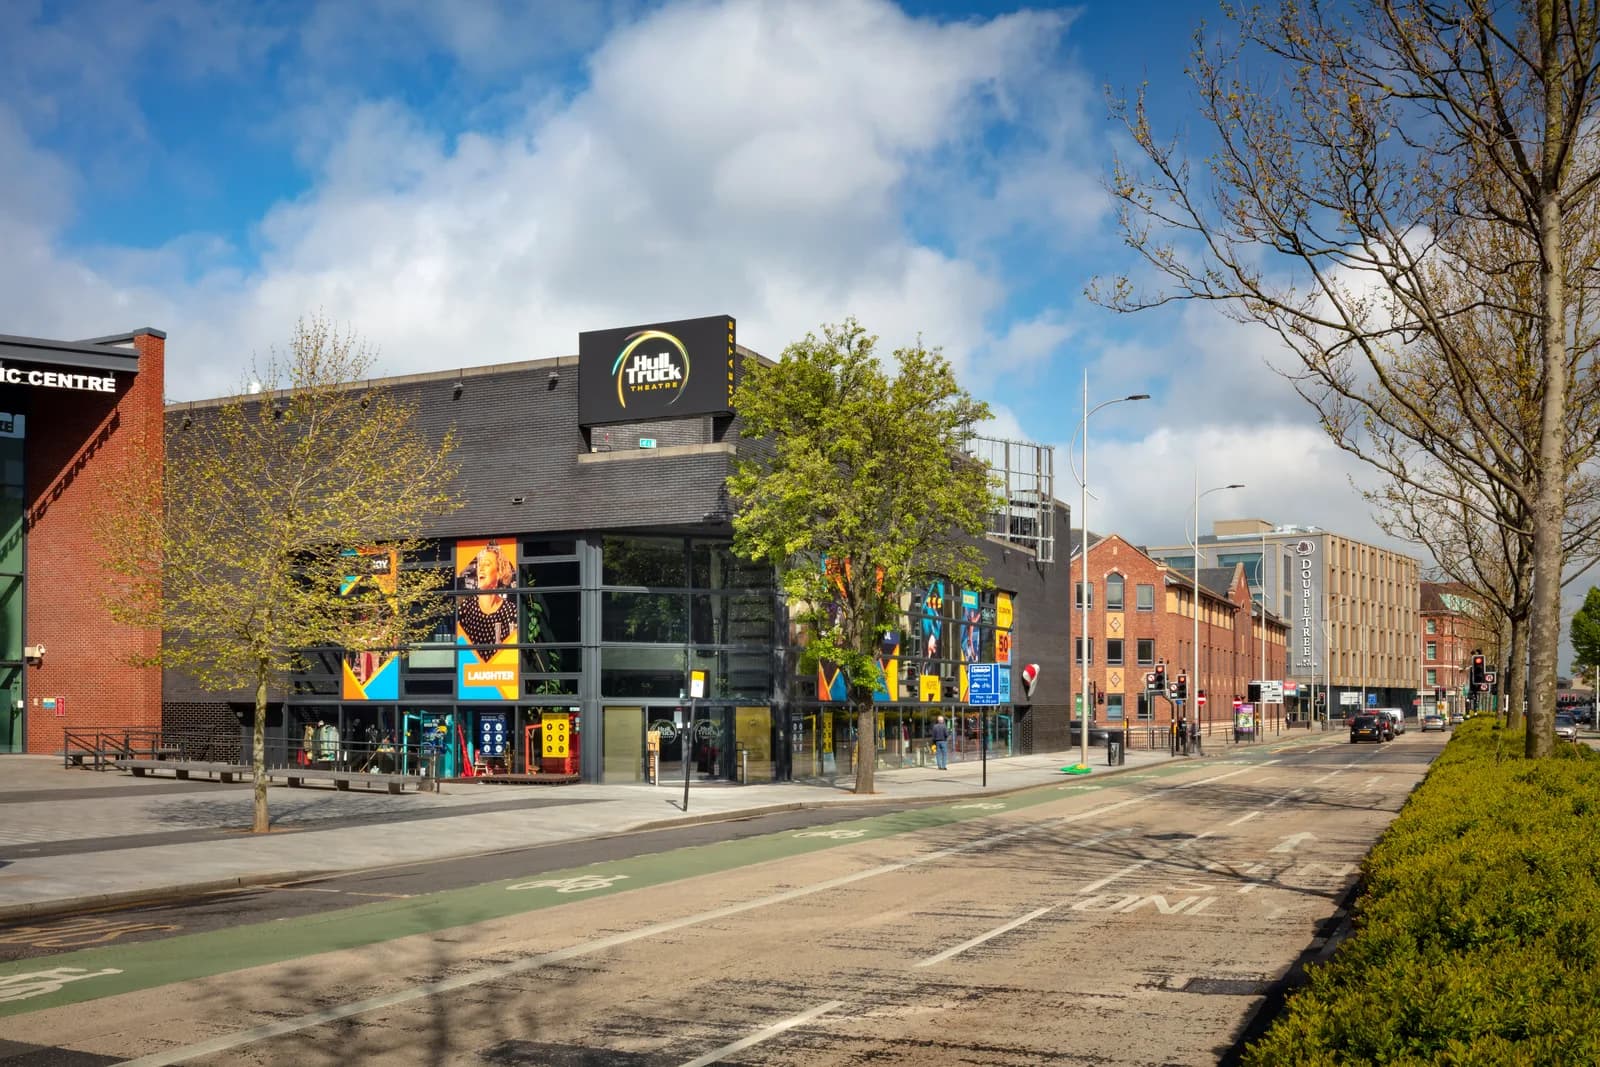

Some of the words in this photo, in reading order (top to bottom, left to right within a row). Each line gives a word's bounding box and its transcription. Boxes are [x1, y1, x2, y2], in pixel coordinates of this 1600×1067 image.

[634, 352, 670, 371] Hull
[28, 370, 116, 392] CENTRE
[625, 363, 682, 384] Truck
[630, 382, 678, 392] THEATRE
[1301, 559, 1312, 656] DOUBLETREE
[999, 635, 1008, 652] 50
[467, 671, 515, 681] LAUGHTER
